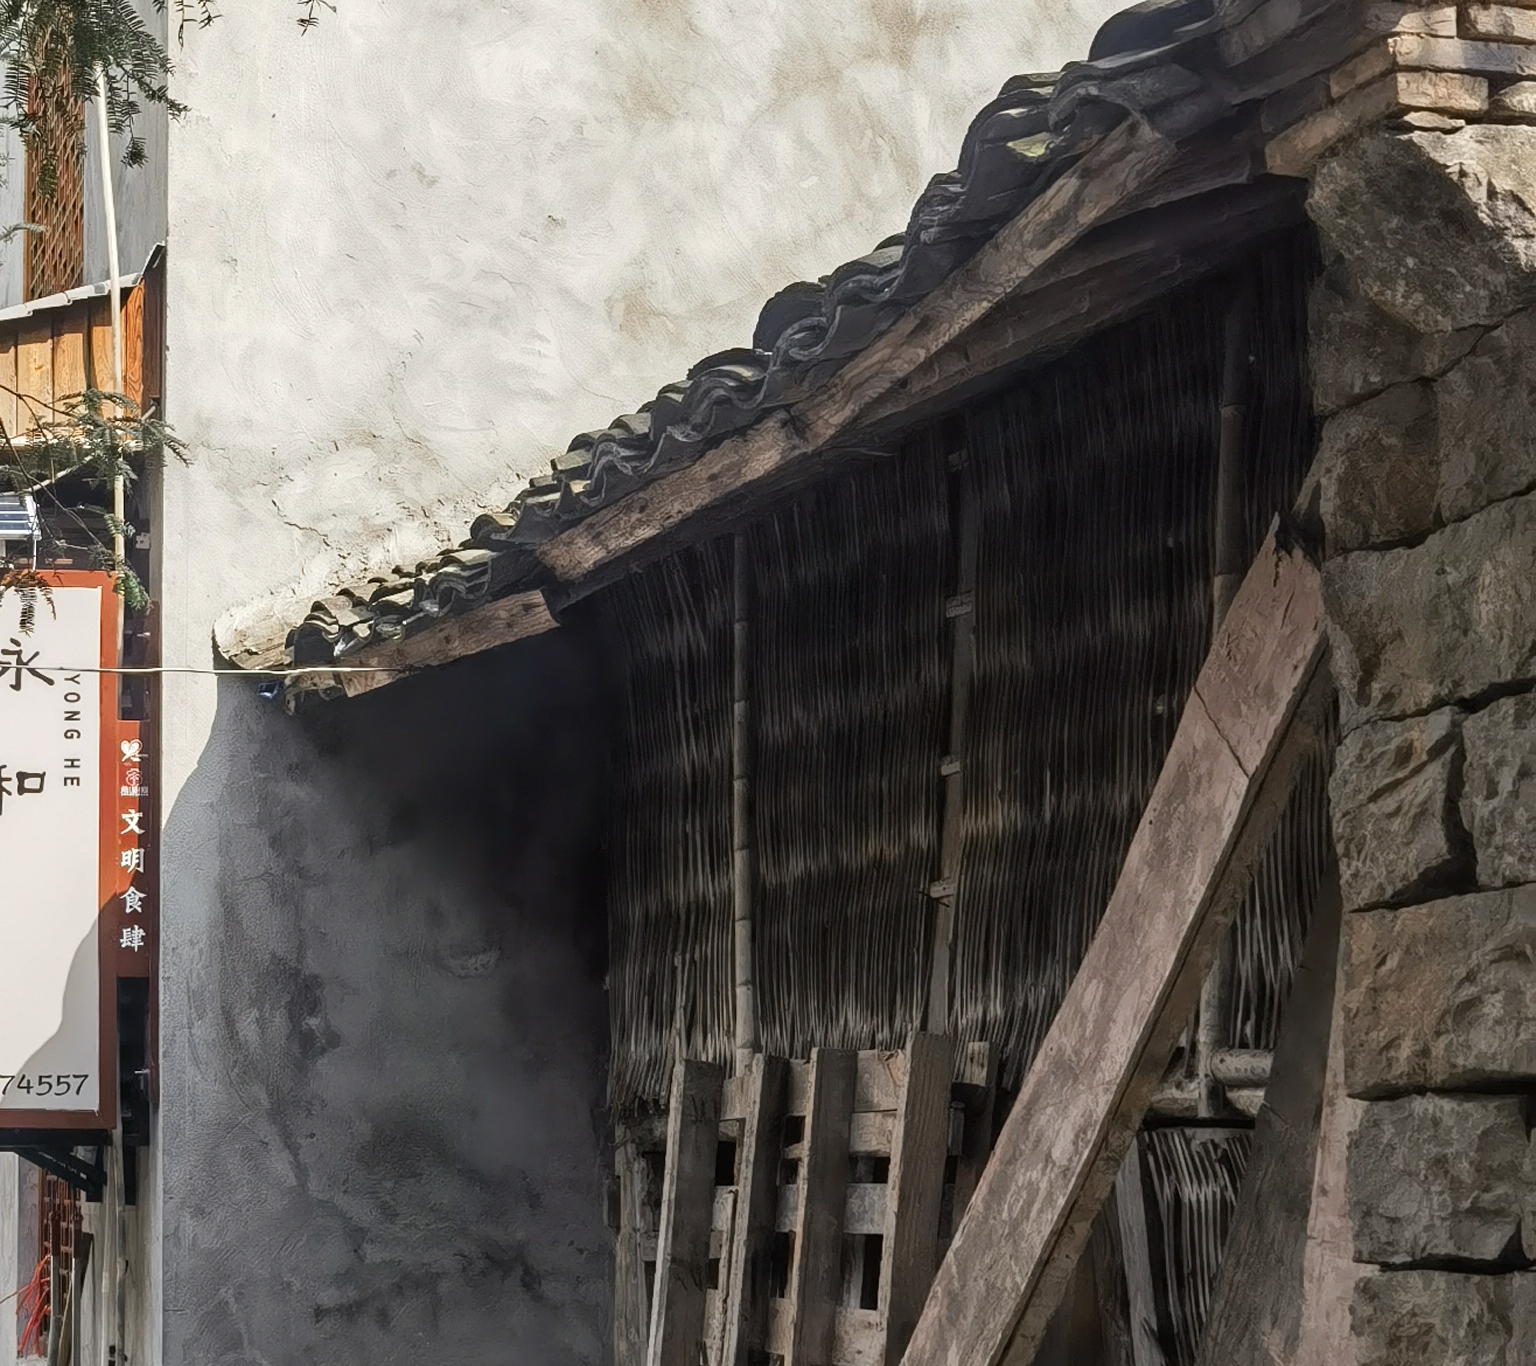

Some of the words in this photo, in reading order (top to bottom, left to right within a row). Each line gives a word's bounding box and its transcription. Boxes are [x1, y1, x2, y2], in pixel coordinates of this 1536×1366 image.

[63, 672, 82, 741] YONG
[63, 757, 82, 788] HE
[119, 808, 148, 953] 文明食肆
